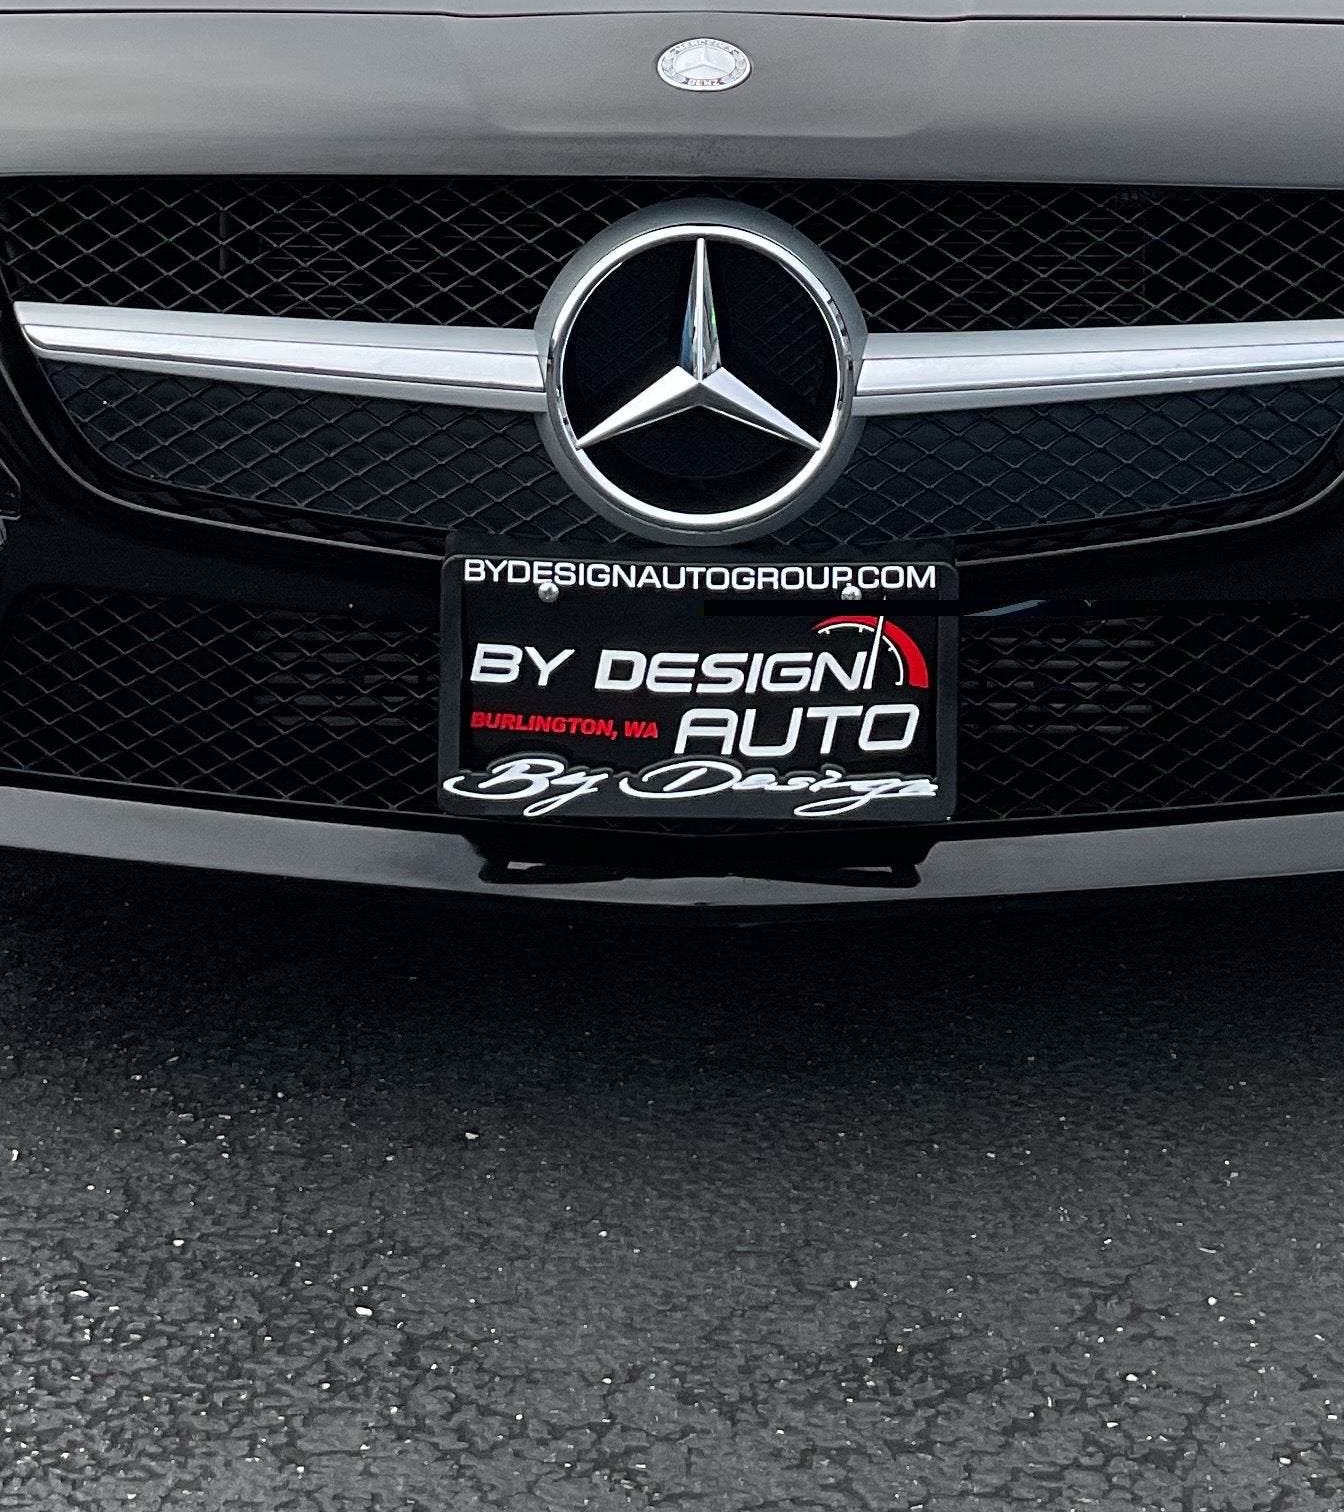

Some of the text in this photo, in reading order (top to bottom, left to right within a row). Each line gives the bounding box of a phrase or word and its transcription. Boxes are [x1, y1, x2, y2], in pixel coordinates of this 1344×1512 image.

[463, 559, 937, 590] BYDESIGNAUTOGROUP.COM
[469, 642, 868, 694] BY DESIGN
[470, 710, 659, 740] BURLINGTON, WA
[673, 702, 920, 758] AUTO
[443, 757, 939, 817] By Design
